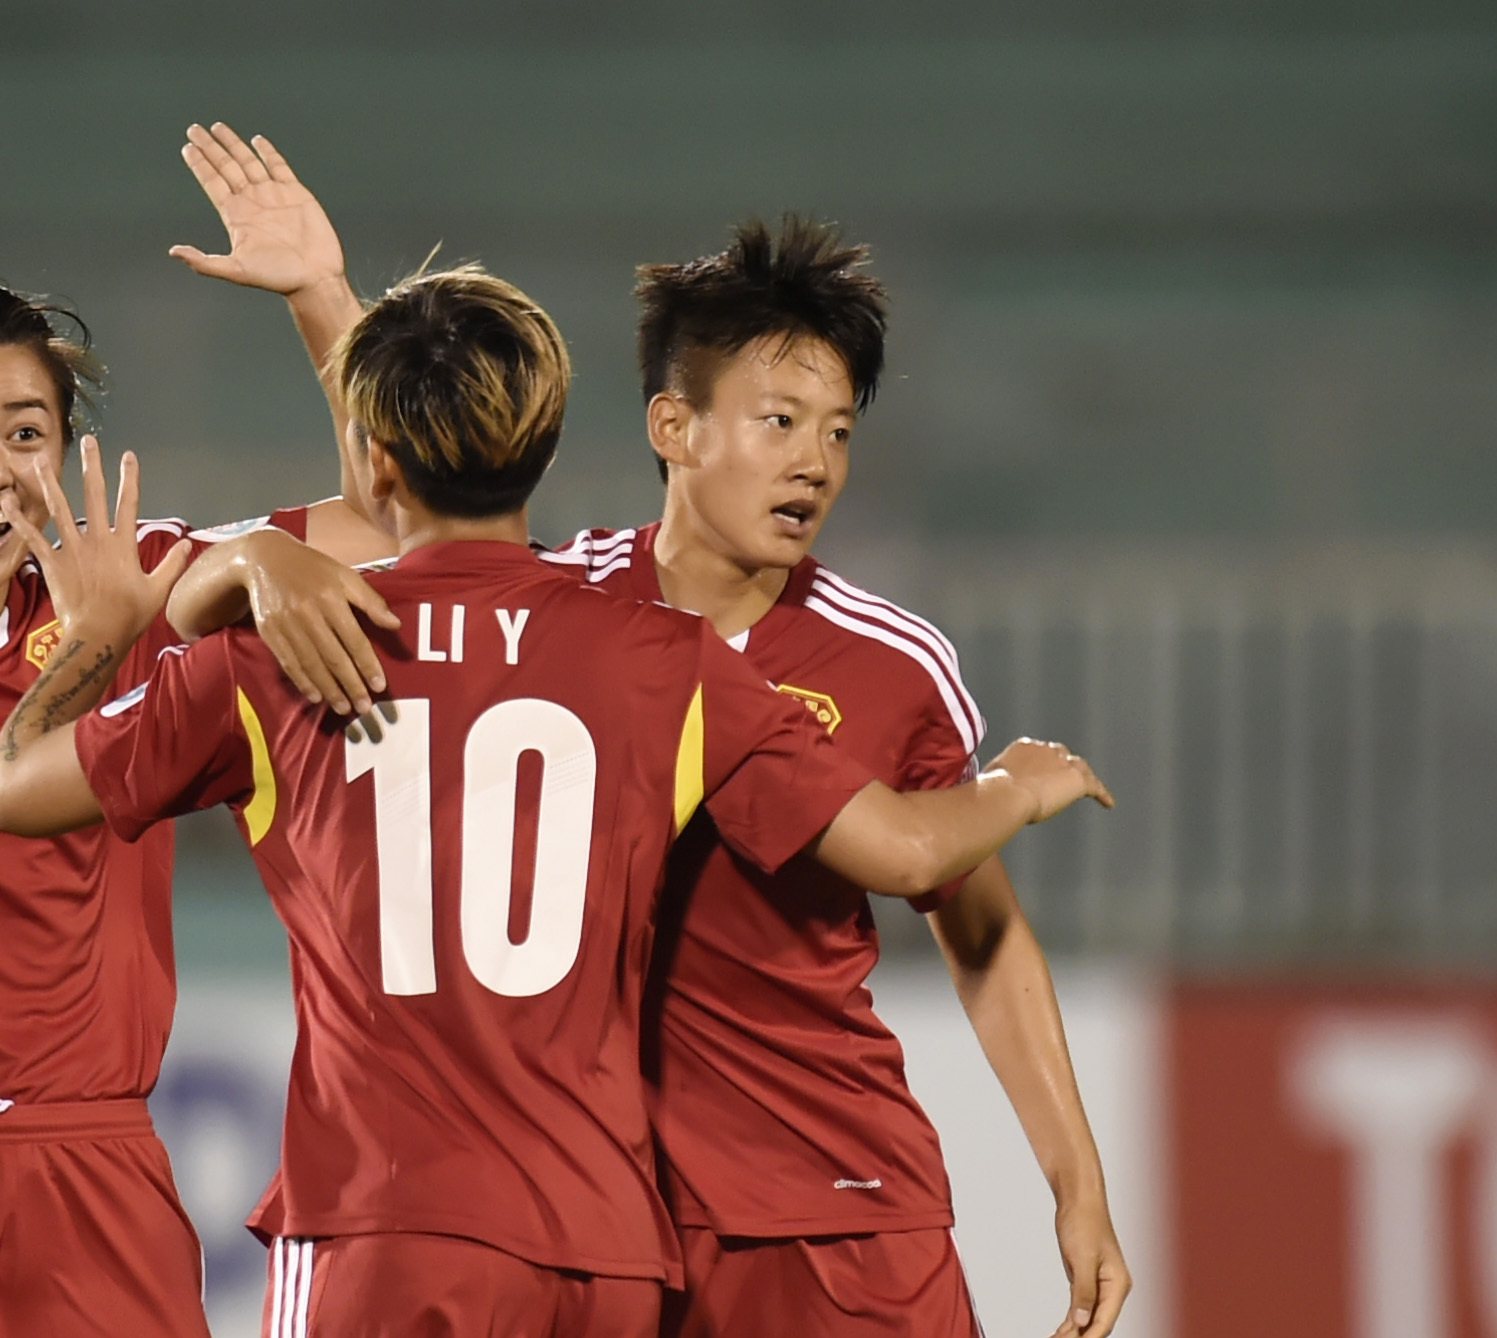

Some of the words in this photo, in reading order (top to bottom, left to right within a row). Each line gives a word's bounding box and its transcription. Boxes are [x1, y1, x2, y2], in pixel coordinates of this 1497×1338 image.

[417, 603, 465, 662] LI
[494, 608, 531, 665] Y
[344, 698, 597, 997] 10
